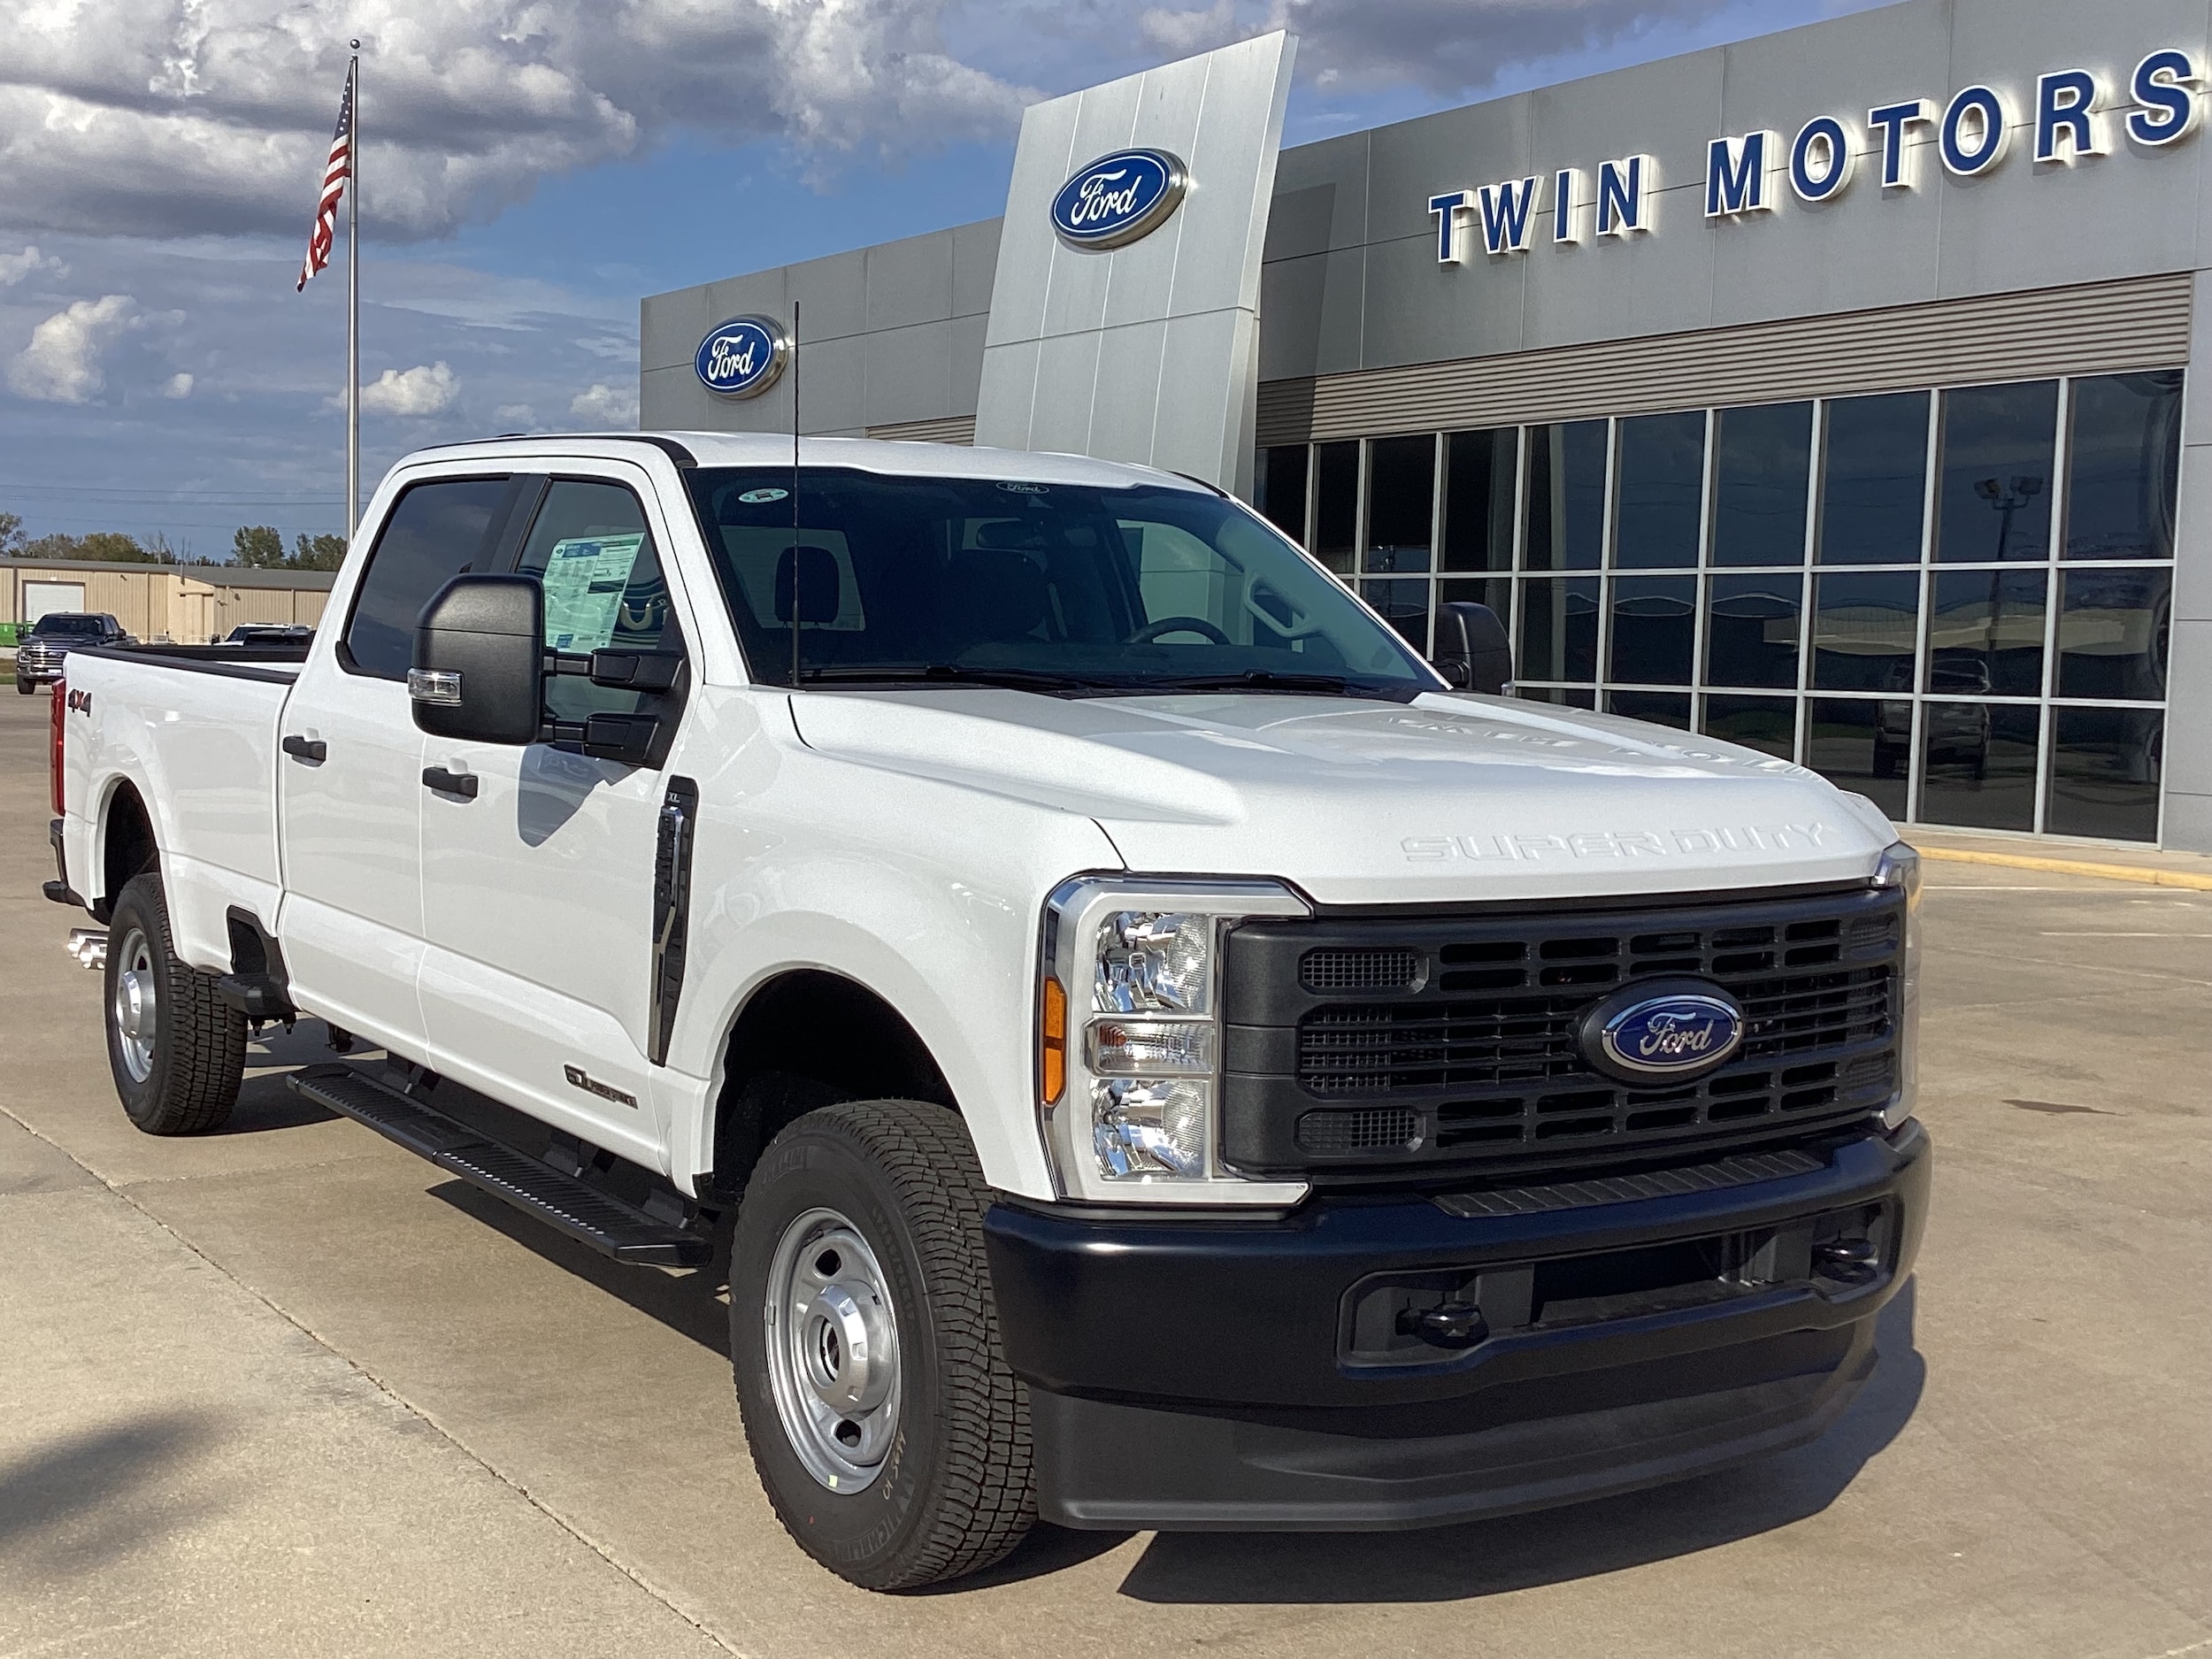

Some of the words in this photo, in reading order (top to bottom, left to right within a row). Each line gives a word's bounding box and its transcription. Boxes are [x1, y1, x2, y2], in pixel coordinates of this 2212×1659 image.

[1428, 154, 1648, 263] TWIN
[1704, 47, 2198, 218] MOTORS
[1071, 168, 1142, 226] Ford
[708, 334, 755, 380] Ford
[667, 791, 680, 803] XL
[1400, 830, 1667, 863] SUPER
[1670, 821, 1824, 855] DUTY
[1640, 1012, 1714, 1056] Ford
